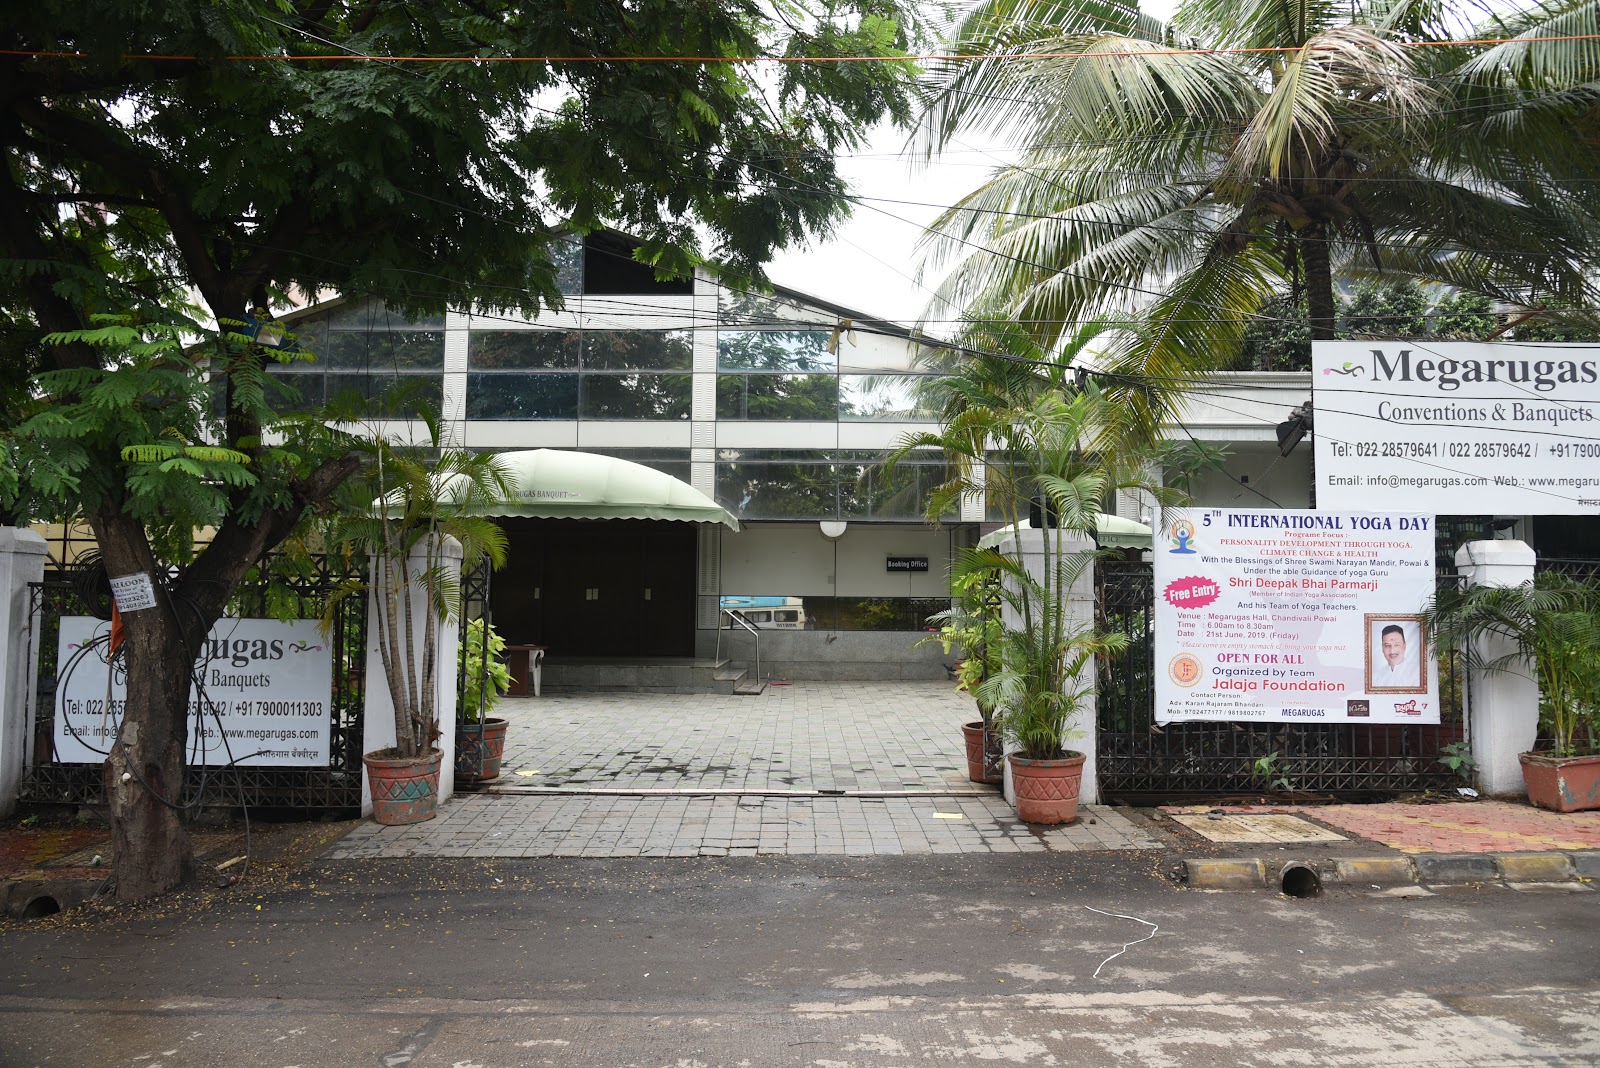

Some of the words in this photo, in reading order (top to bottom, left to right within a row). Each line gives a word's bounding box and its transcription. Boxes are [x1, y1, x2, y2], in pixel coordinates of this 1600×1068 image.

[1369, 349, 1598, 391] Megarugas
[1378, 401, 1487, 421] Conventions
[1491, 403, 1506, 421] &
[1512, 402, 1592, 426] Banquets
[1331, 442, 1352, 457] Tel:
[1356, 443, 1377, 457] 022
[1382, 443, 1437, 457] 28579641
[1450, 443, 1470, 457] 022
[1474, 443, 1531, 458] 28579642
[1329, 475, 1363, 486] Email:
[1367, 475, 1487, 487] info@megarugas.com
[1494, 476, 1525, 486] Web.:
[1528, 477, 1600, 488] www.megaru
[1228, 514, 1343, 529] INTERNATIONAL
[1350, 517, 1392, 530] YOGA
[1399, 518, 1430, 530] DAY
[1235, 557, 1272, 565] Blessings
[1336, 559, 1367, 567] Narayan
[111, 578, 144, 588] ALLOON
[1229, 577, 1252, 587] Shri
[1256, 578, 1298, 590] Deepak
[1302, 579, 1326, 588] Bhai
[1331, 579, 1378, 592] Parmarji
[1170, 589, 1190, 601] Free
[1192, 585, 1215, 598] Entry
[1209, 613, 1250, 621] Megarugas
[1270, 632, 1299, 640] (Friday)
[1217, 653, 1250, 663] OPEN
[1254, 654, 1278, 663] FOR
[1282, 655, 1304, 664] ALL
[1212, 667, 1268, 677] Organized
[1273, 668, 1286, 677] by
[211, 669, 270, 692] Banquets
[1212, 679, 1257, 692] Jalaja
[1263, 679, 1345, 691] Foundation
[67, 699, 82, 714] Tel:
[86, 700, 103, 714] 022
[236, 701, 252, 716] +91
[256, 701, 322, 716] 7900011303
[64, 725, 90, 736] Email:
[222, 729, 318, 739] www.megarugas.com
